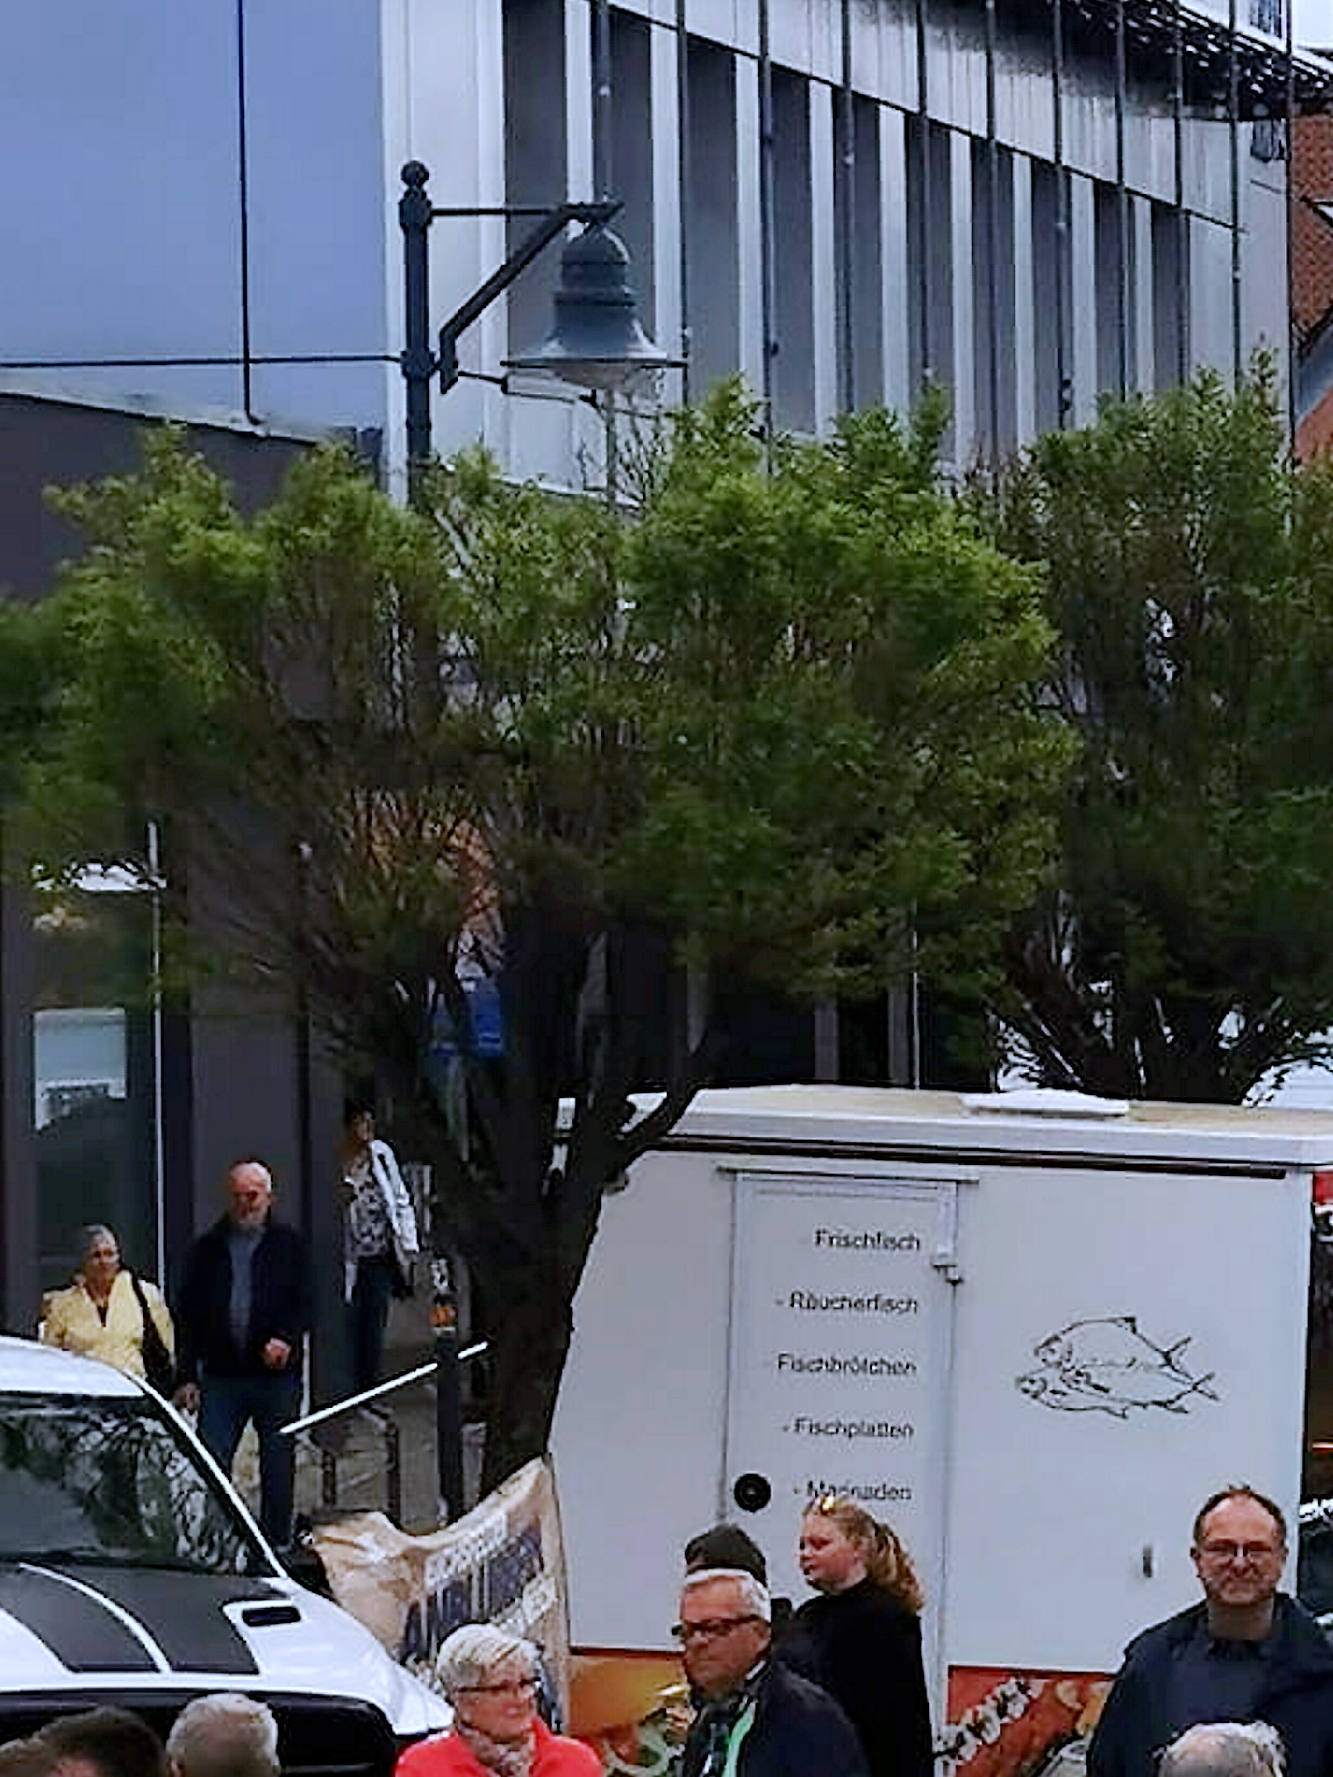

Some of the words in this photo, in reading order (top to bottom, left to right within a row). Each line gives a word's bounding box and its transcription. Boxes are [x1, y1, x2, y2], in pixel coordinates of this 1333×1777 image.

[815, 1228, 920, 1252] Frischfisch
[789, 1290, 918, 1314] Räucherfisch
[795, 1417, 914, 1440] Fischplatten
